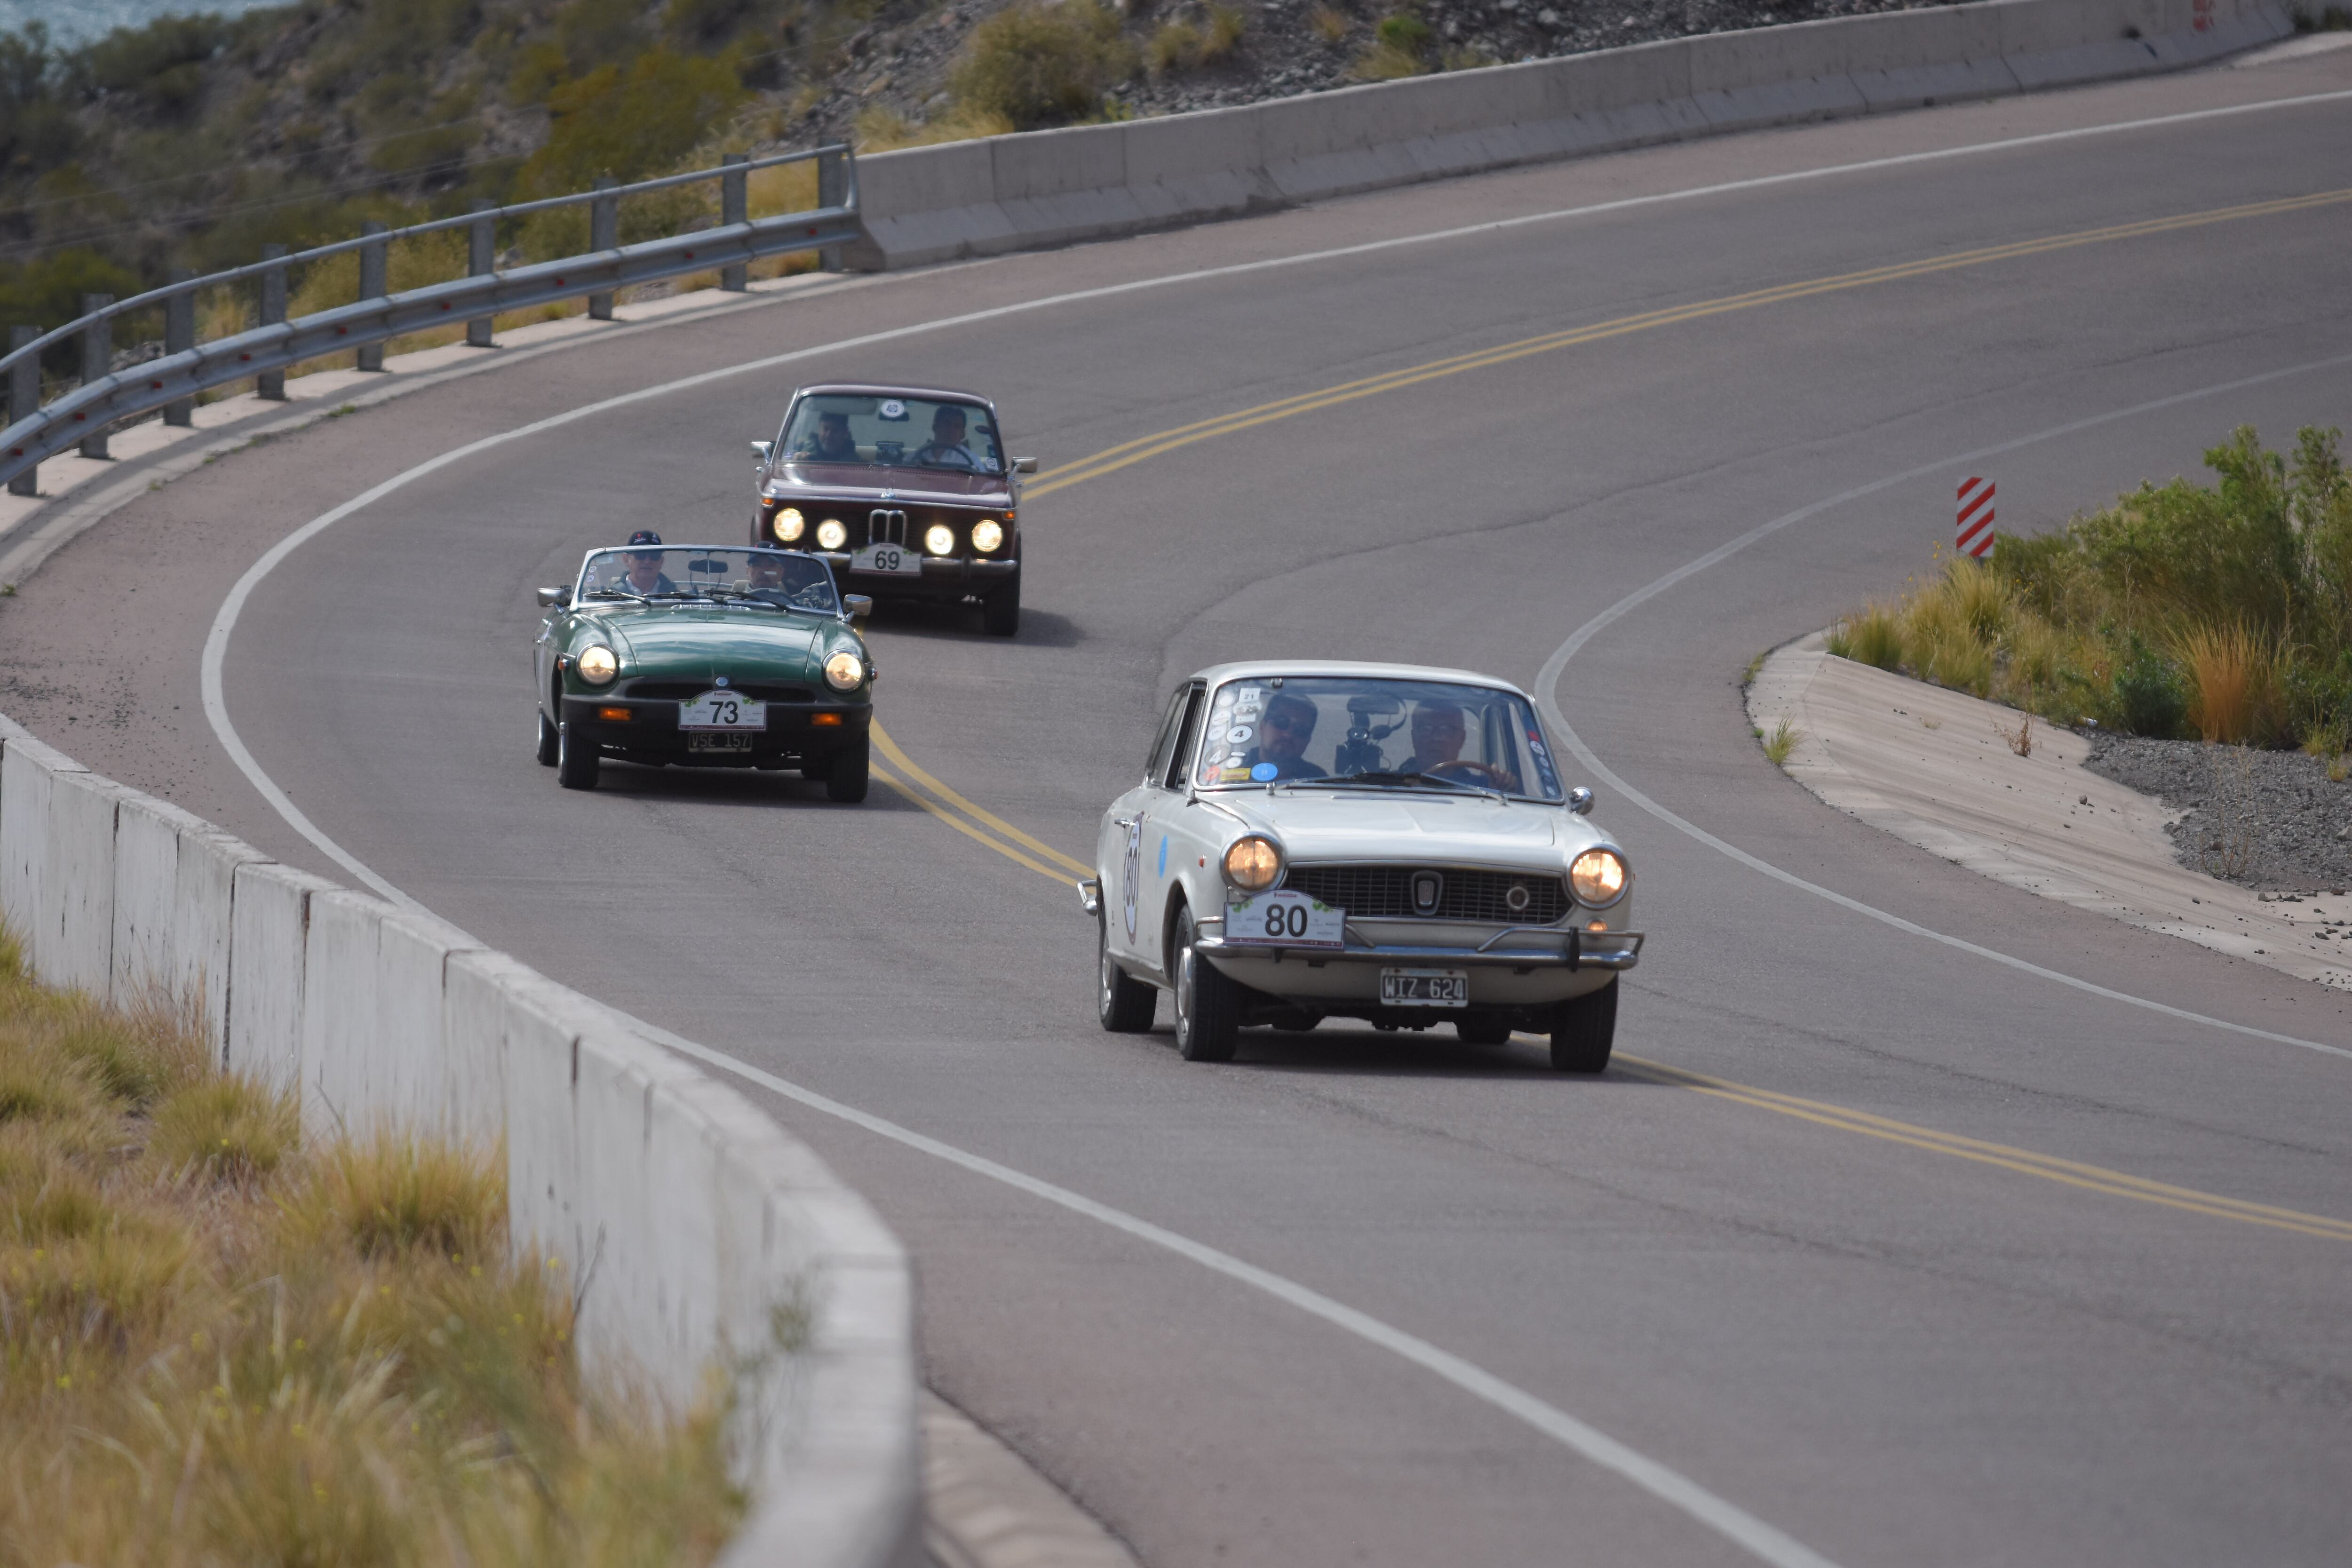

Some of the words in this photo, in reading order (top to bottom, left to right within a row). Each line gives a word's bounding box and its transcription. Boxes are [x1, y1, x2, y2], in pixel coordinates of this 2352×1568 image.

[875, 550, 900, 570] 69
[709, 700, 739, 724] 73
[692, 734, 715, 747] VSE
[724, 734, 749, 747] 157
[1127, 846, 1137, 907] 80
[1265, 903, 1308, 937] 80
[1384, 977, 1418, 998] WIZ
